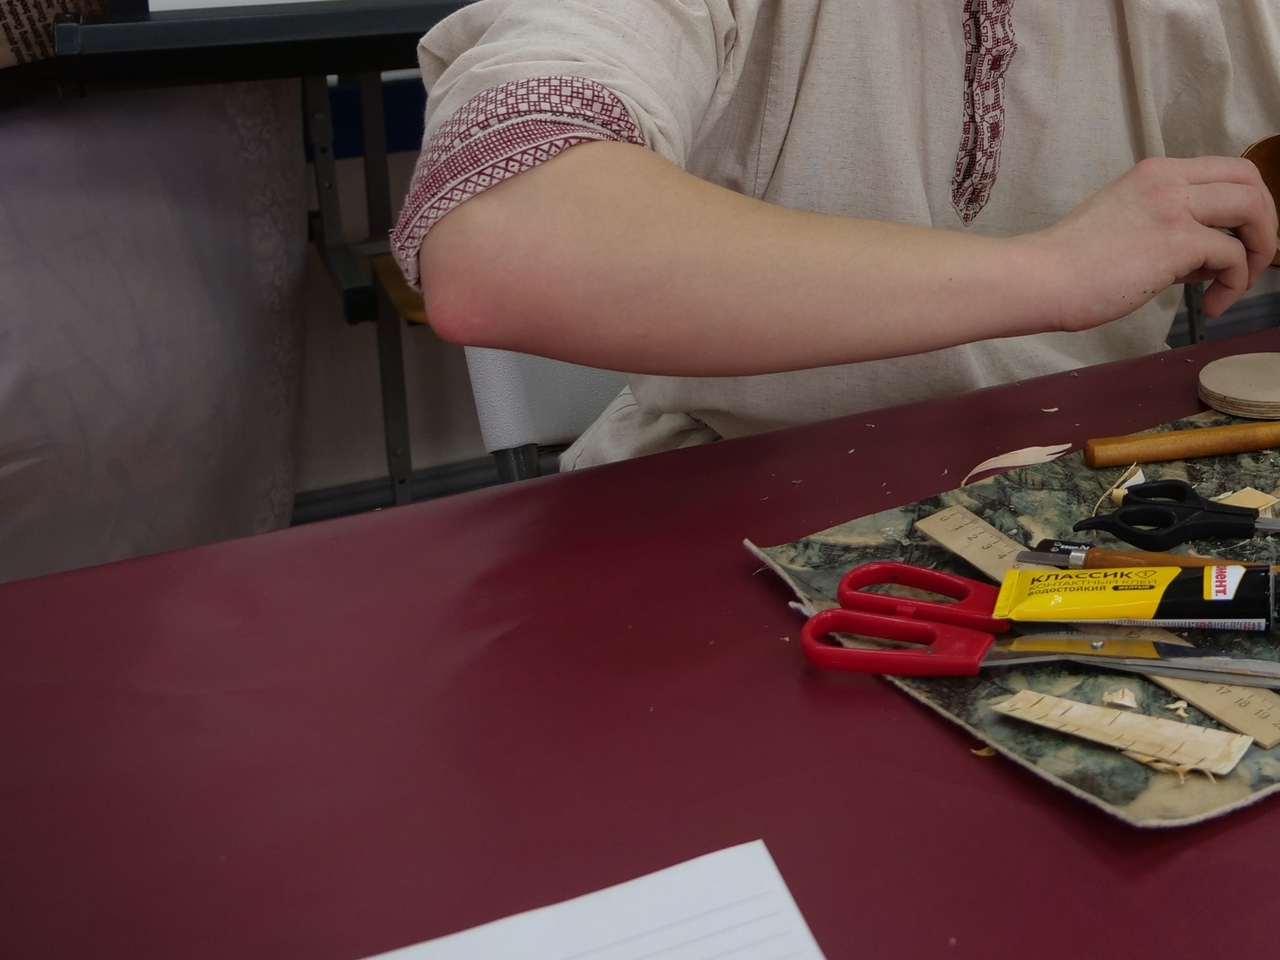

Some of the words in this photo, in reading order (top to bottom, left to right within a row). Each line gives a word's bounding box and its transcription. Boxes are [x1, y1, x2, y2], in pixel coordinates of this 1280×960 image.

[1029, 578, 1119, 592] КОНТАКТНЫЙ
[1122, 577, 1158, 586] КЛЕЙ
[1030, 571, 1133, 586] КЛАССИК
[1027, 585, 1106, 597] ВОДОСТОЙКИЙ
[1214, 686, 1232, 696] 17
[1234, 697, 1250, 709] 18
[1254, 708, 1270, 720] 19
